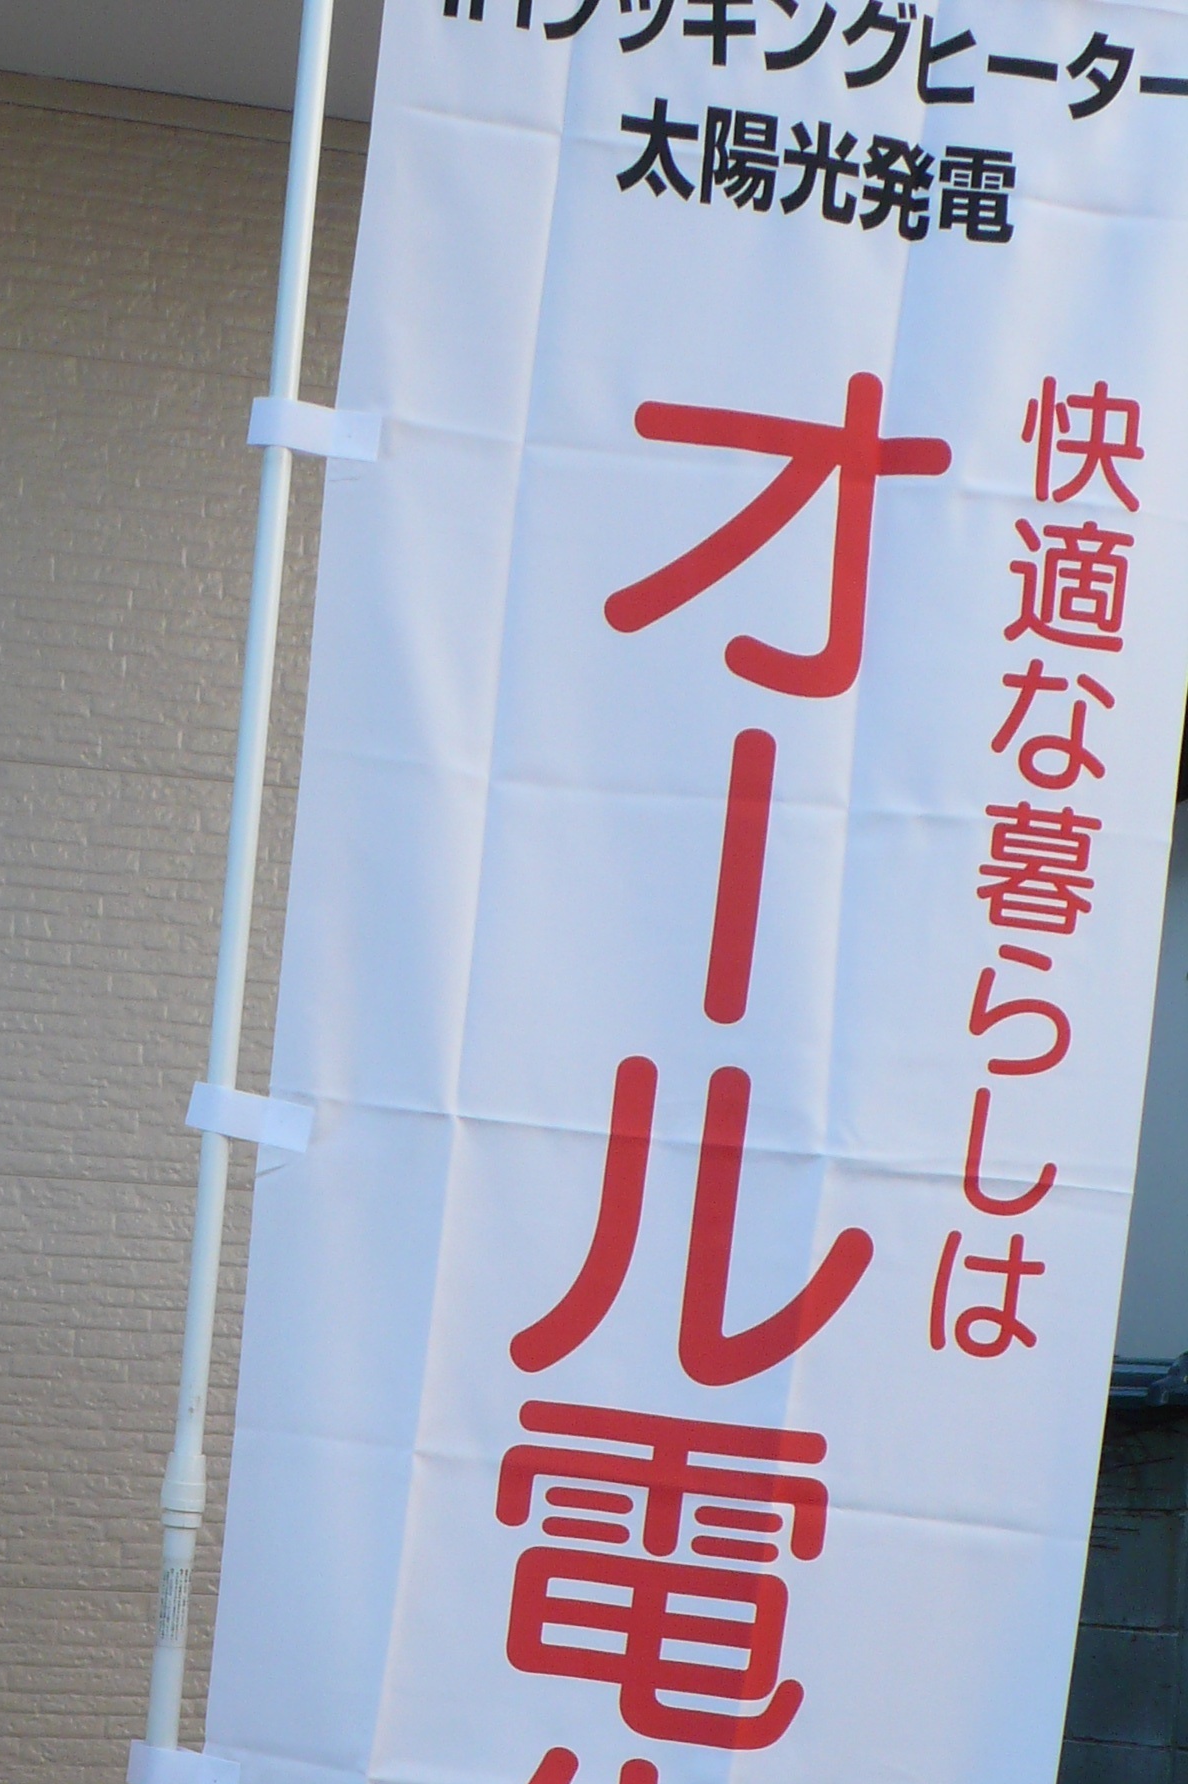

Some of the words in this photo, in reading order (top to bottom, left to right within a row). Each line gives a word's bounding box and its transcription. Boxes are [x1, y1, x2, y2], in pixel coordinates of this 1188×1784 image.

[442, 0, 1188, 120] ッキングヒーター
[616, 97, 1016, 244] 太陽光発電
[928, 375, 1145, 1360] 快適な暮らしは
